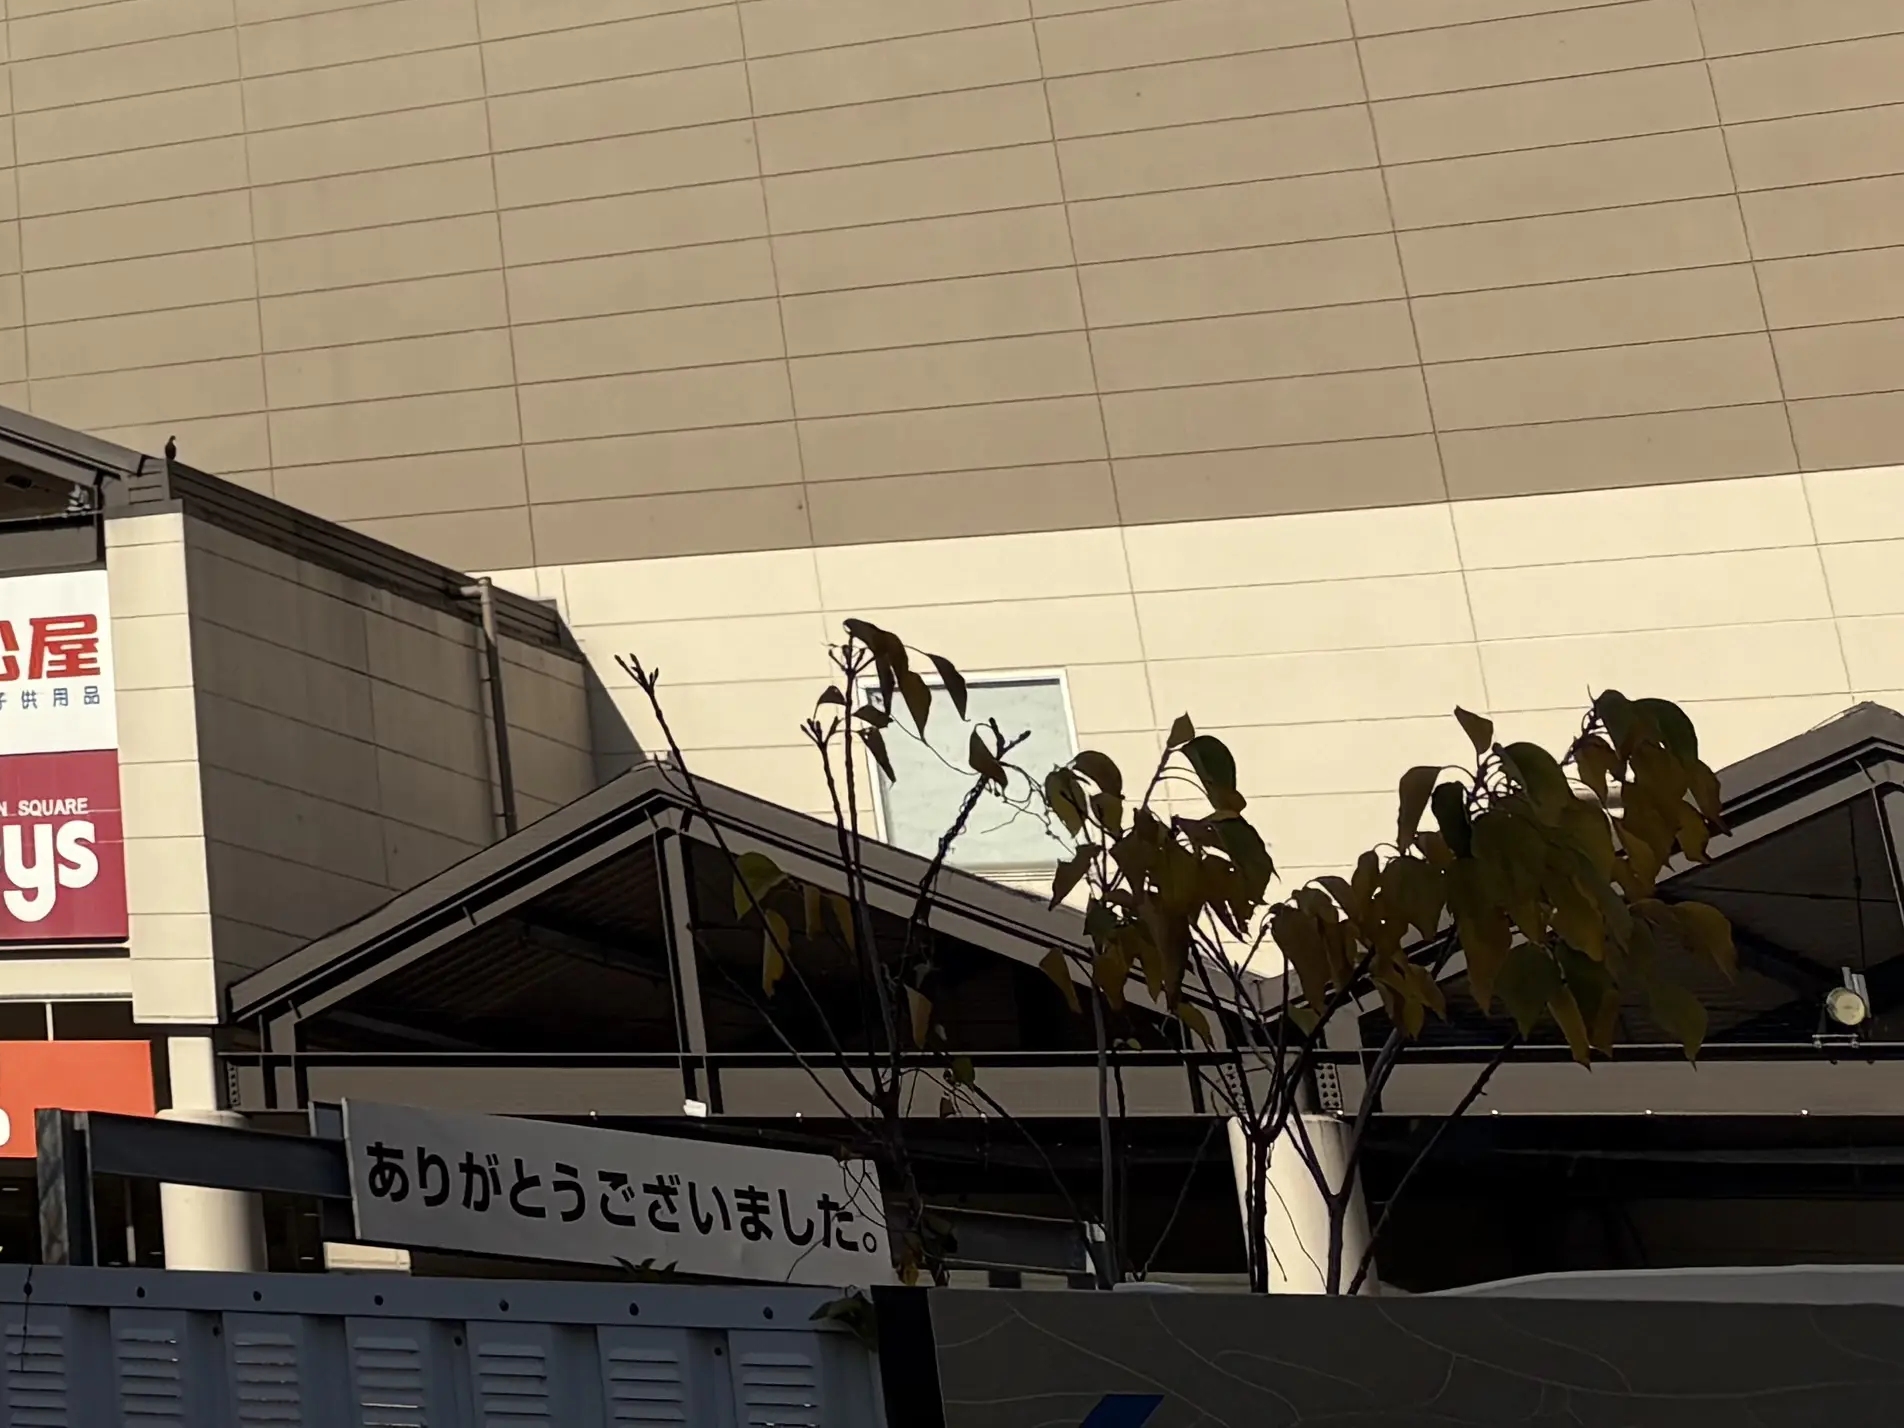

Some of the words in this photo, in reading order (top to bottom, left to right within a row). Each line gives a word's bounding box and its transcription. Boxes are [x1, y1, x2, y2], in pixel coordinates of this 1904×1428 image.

[17, 797, 89, 817] SQUARE
[367, 1141, 878, 1255] ありがとうございました。
